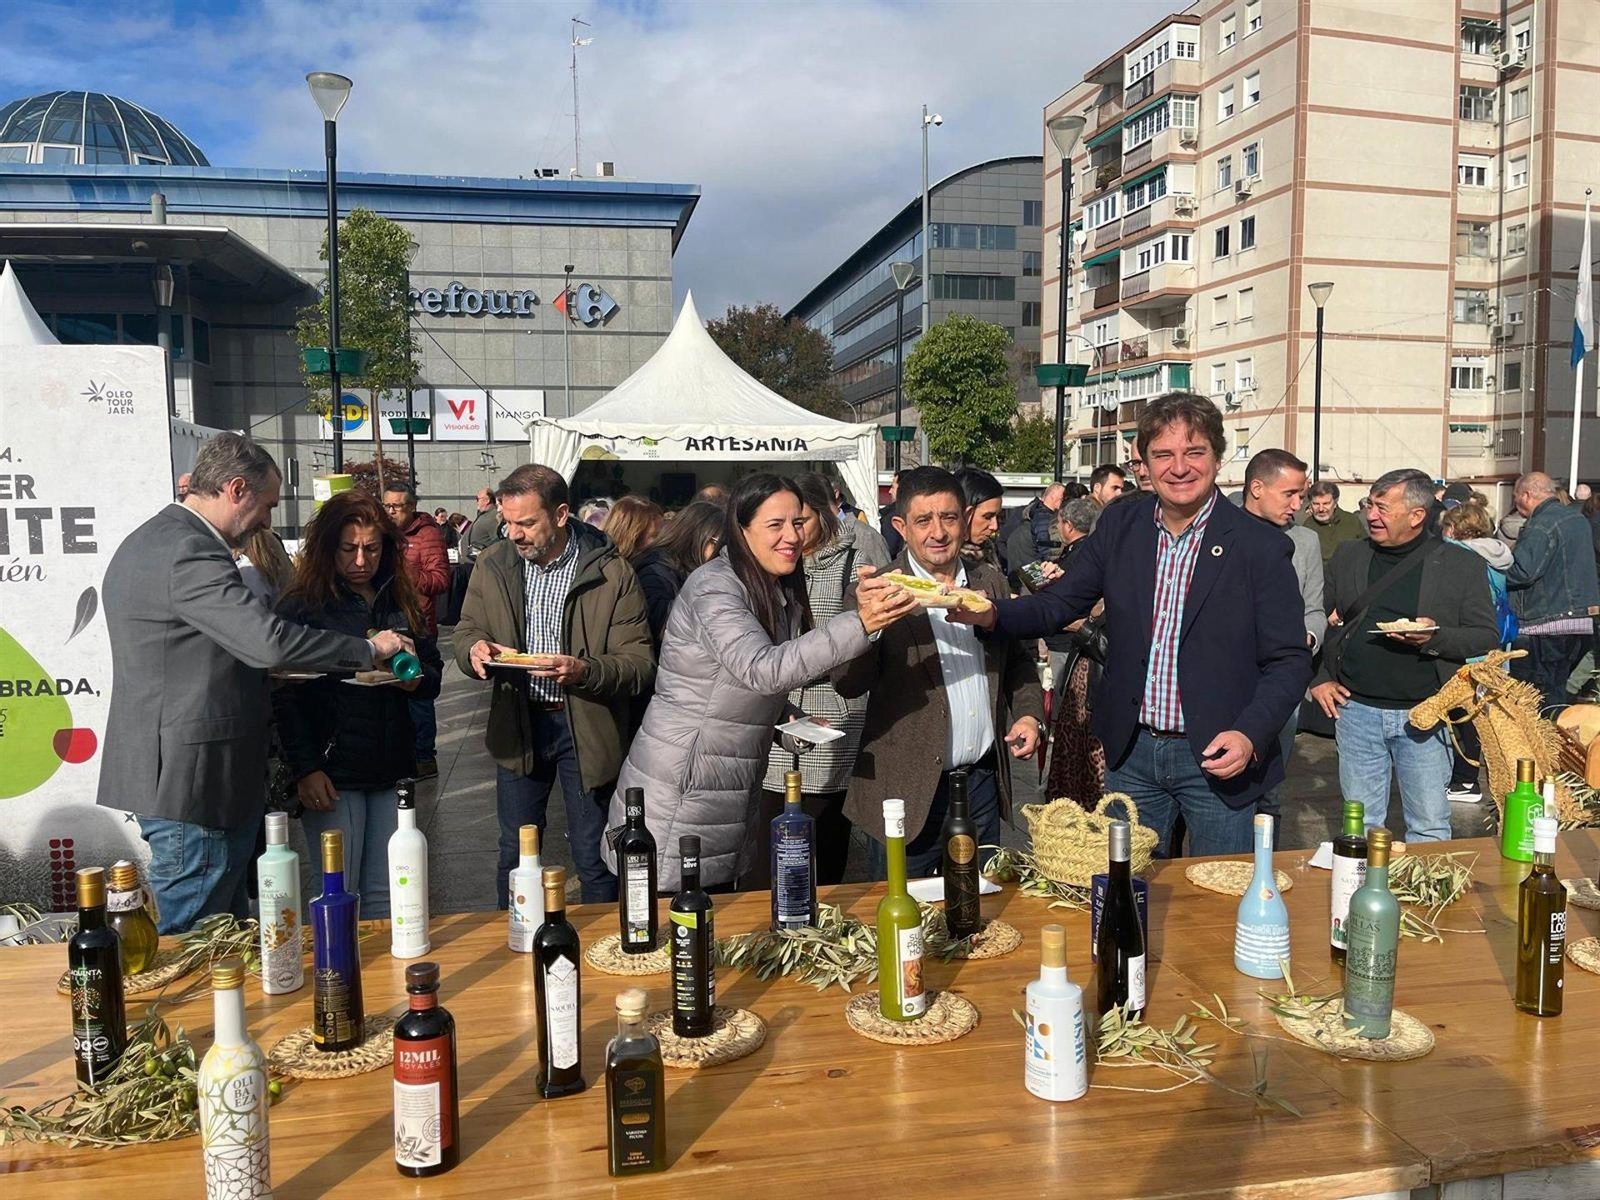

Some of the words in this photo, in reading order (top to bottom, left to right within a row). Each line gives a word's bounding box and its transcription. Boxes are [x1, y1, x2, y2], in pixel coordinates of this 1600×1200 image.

[107, 407, 134, 415] JAEN
[381, 410, 427, 418] RODILA
[495, 411, 541, 420] MANGO
[444, 423, 481, 431] VisionLab
[0, 678, 101, 697] BRADA,
[400, 1049, 441, 1063] 12MIL
[400, 1060, 441, 1070] ROYALES
[233, 1076, 254, 1090] OLI
[234, 1087, 250, 1098] BA
[234, 1094, 258, 1108] EZA
